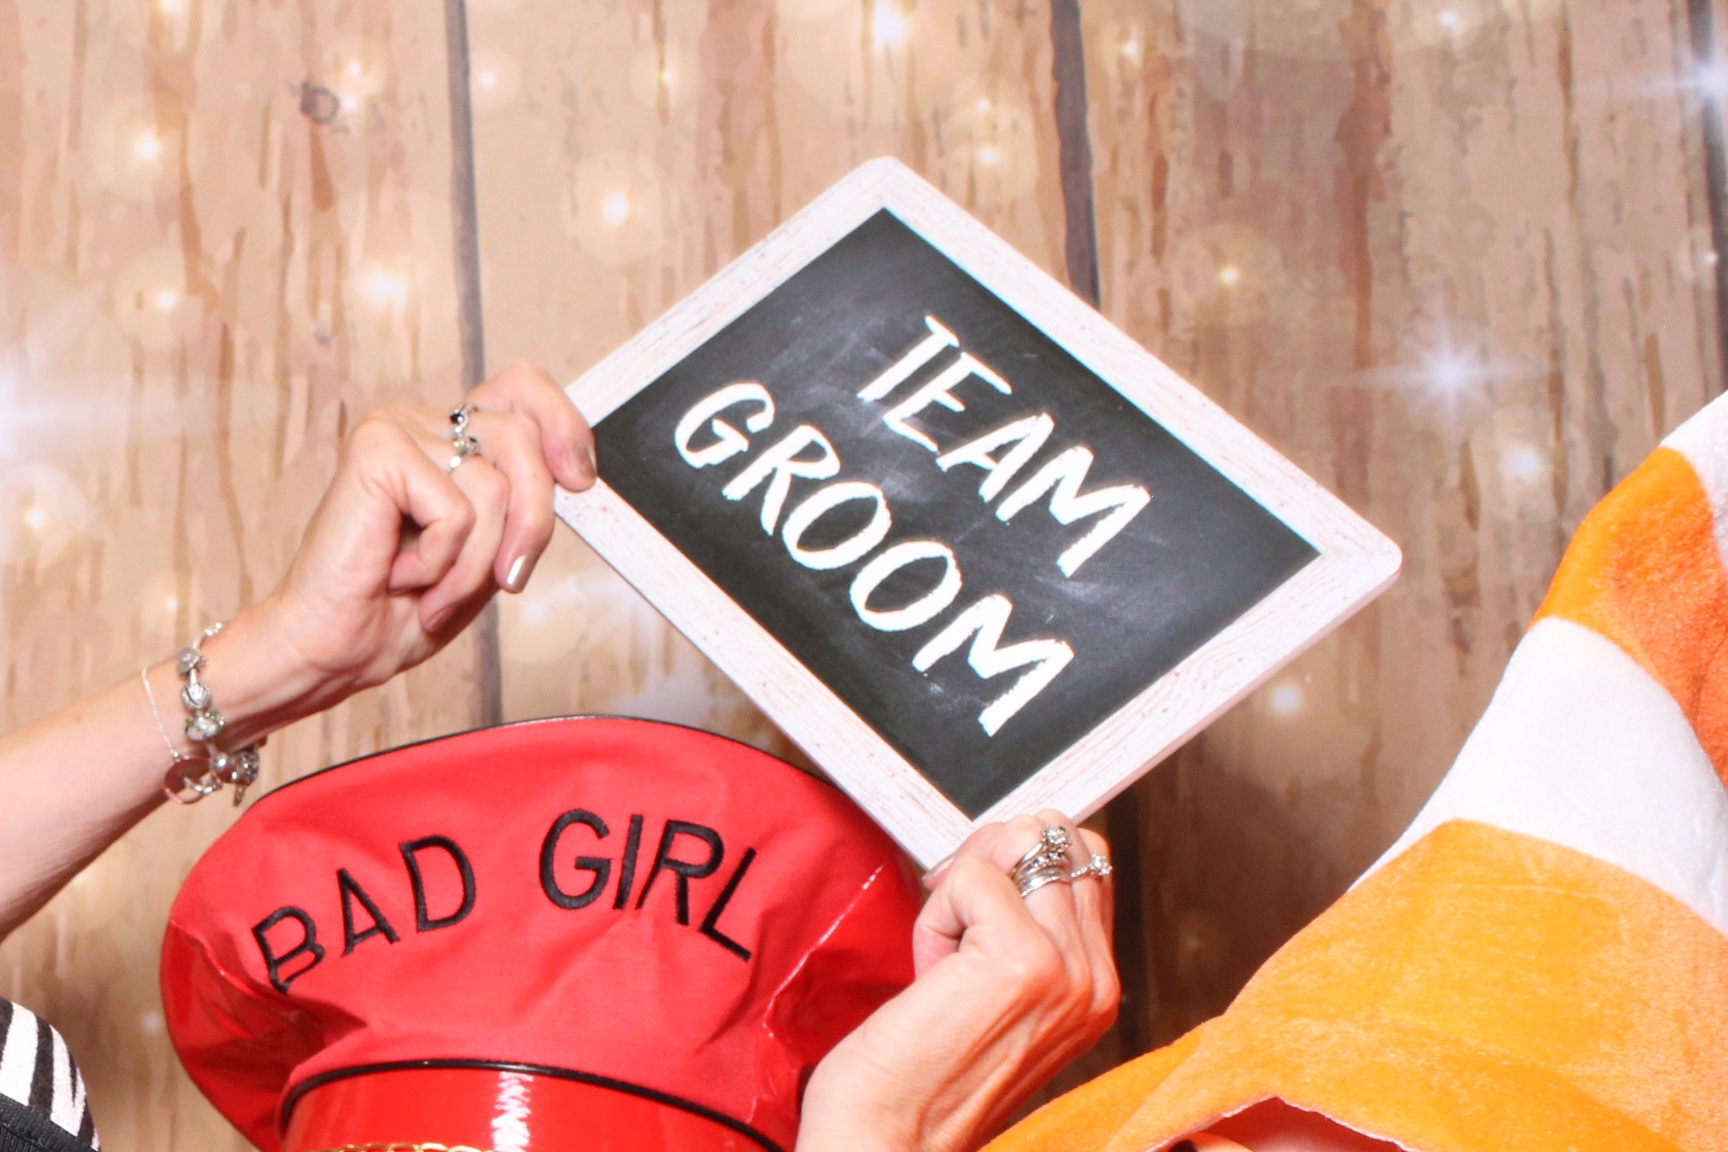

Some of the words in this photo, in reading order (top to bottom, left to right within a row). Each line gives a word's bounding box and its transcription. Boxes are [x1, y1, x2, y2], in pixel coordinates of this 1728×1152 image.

[674, 381, 1075, 738] GROOM
[856, 313, 1153, 578] TEAM
[251, 833, 476, 995] BAD
[539, 808, 757, 963] GIRL
